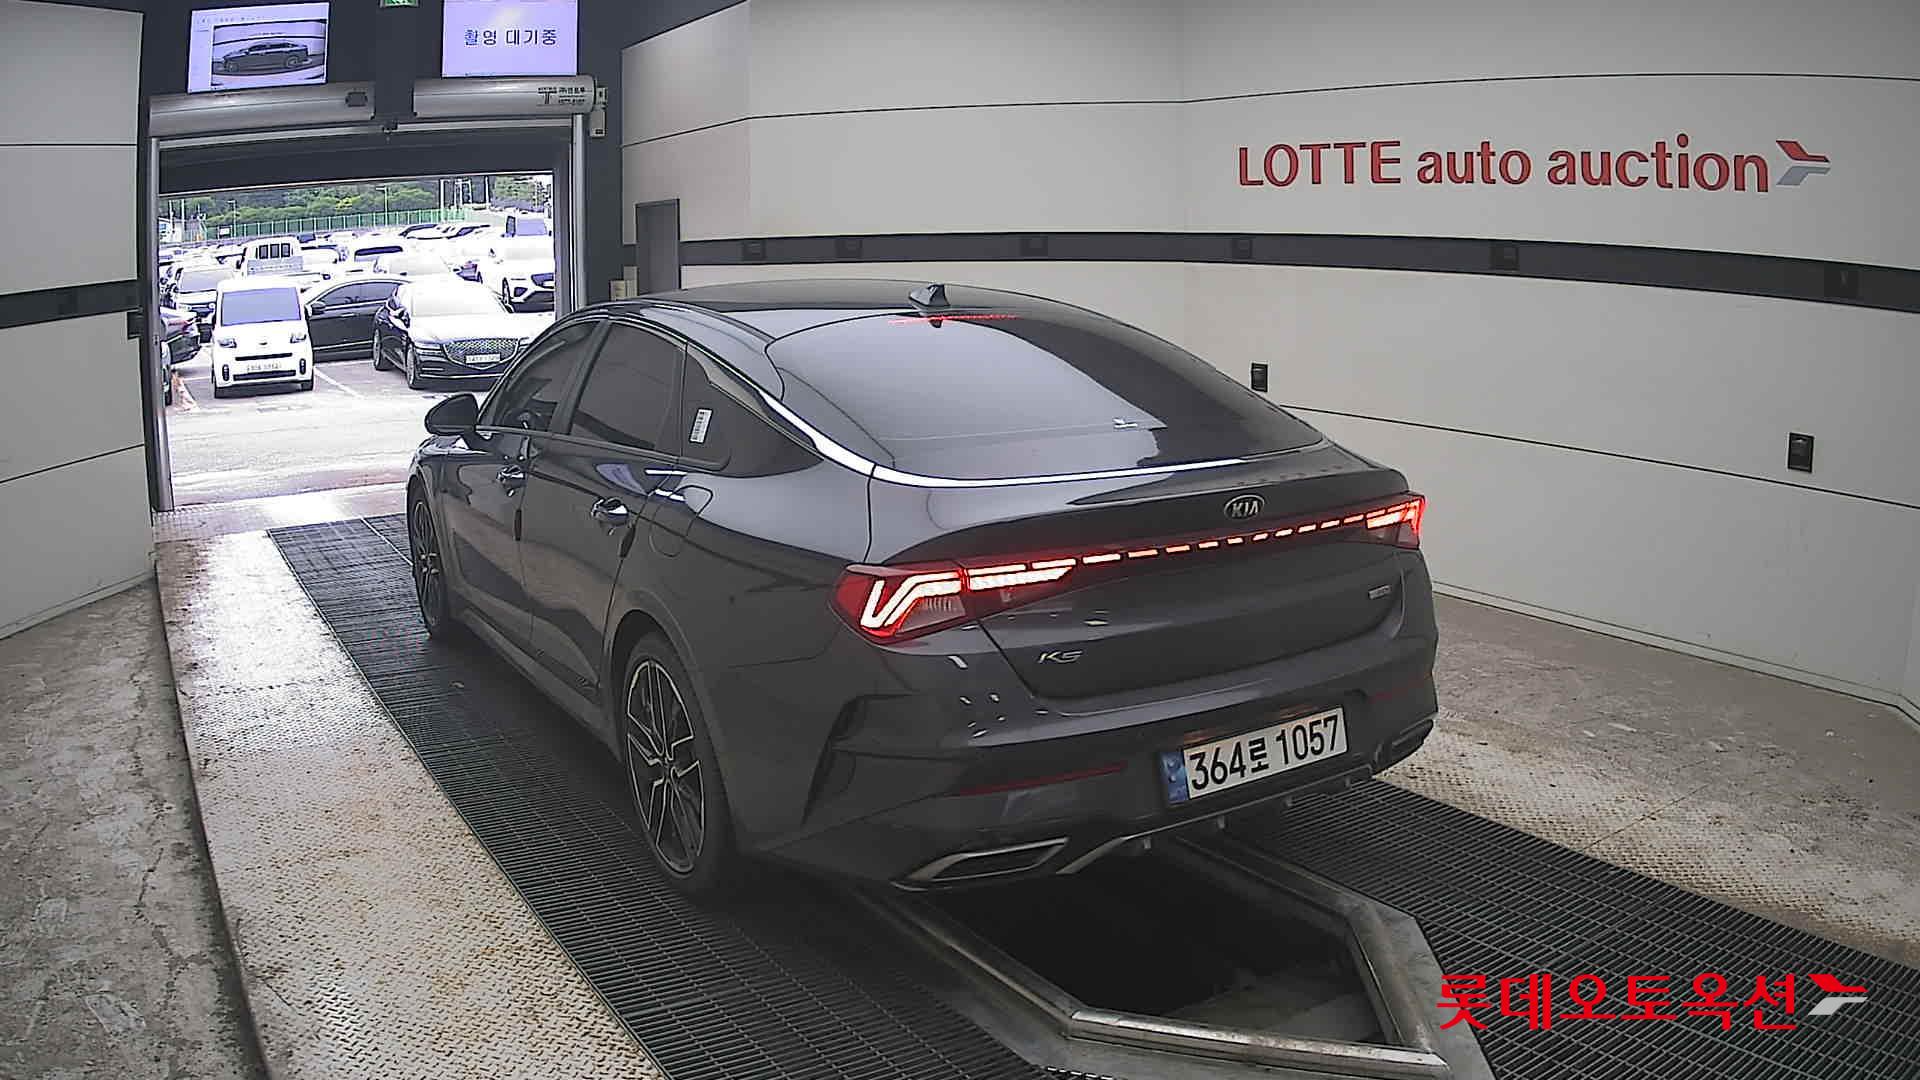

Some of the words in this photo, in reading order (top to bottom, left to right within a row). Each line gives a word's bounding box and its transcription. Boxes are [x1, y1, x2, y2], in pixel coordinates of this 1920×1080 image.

[506, 29, 557, 46] 대기중
[1239, 141, 1401, 187] LOTTE
[1417, 141, 1531, 184] auto
[1548, 133, 1769, 192] auction
[1230, 501, 1259, 519] KIA
[1038, 651, 1084, 664] K5
[1189, 737, 1269, 790] 364로
[1276, 715, 1338, 765] 1057
